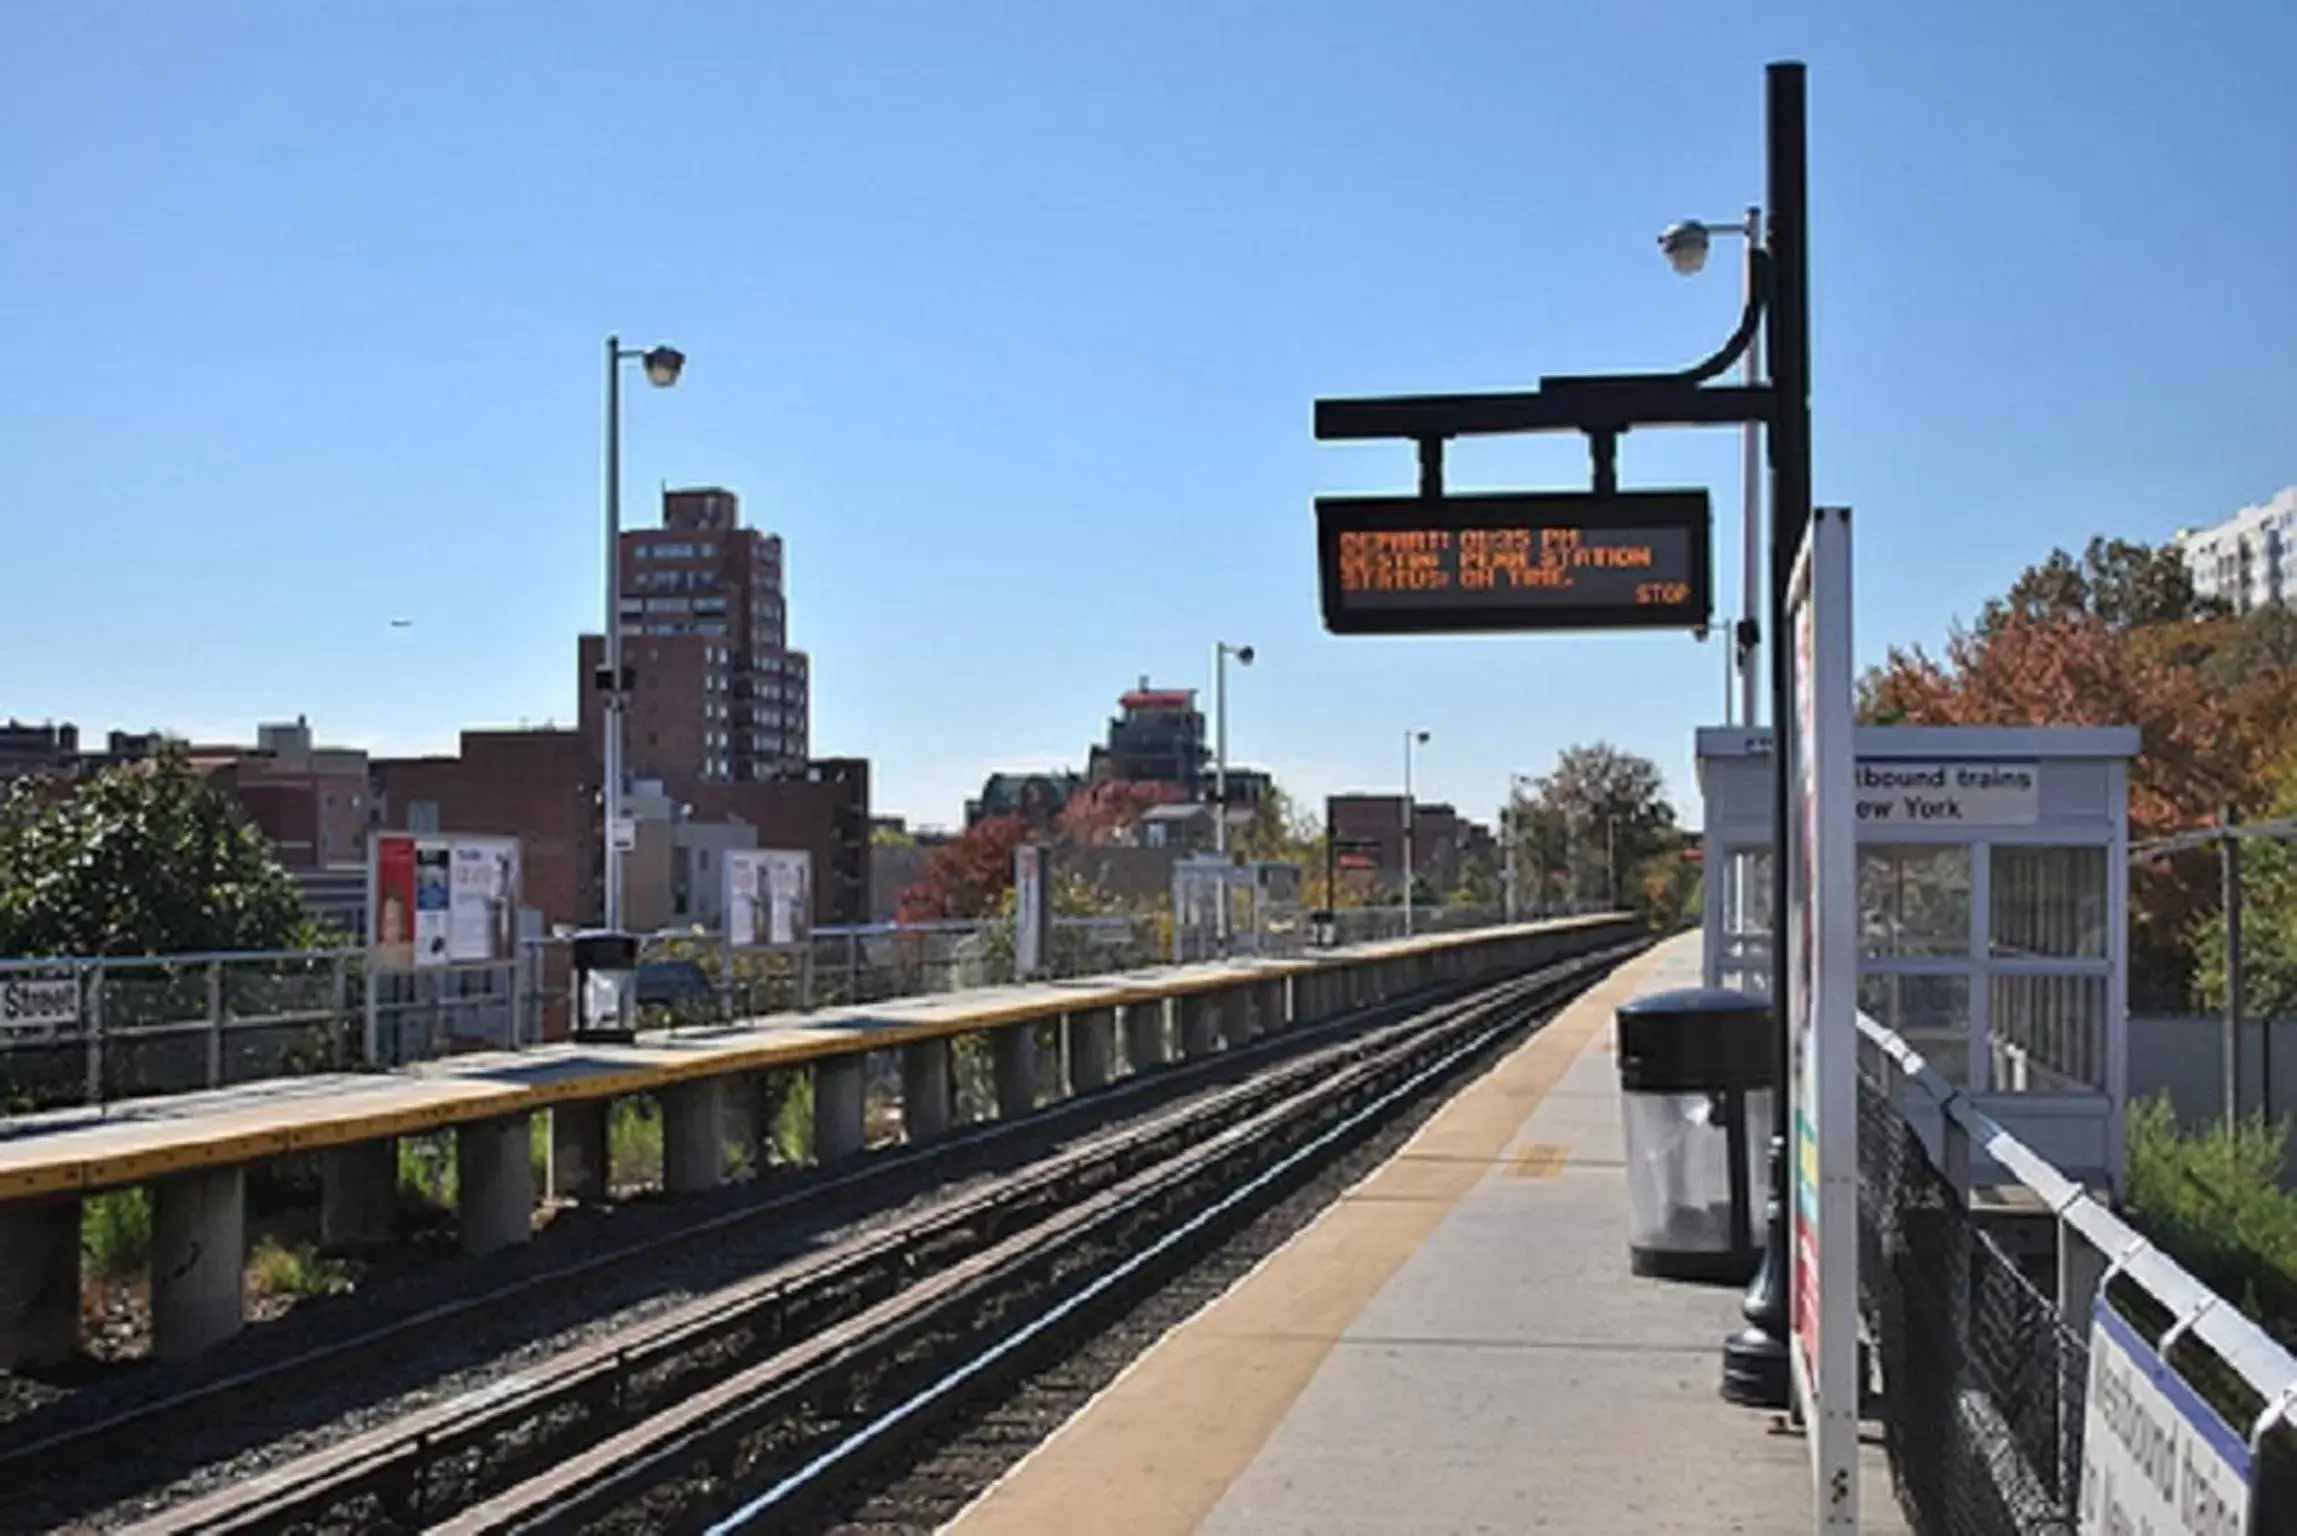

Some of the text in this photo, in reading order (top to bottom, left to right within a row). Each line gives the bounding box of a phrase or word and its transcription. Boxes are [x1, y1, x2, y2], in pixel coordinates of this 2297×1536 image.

[1635, 582, 1691, 604] STOP
[1956, 764, 2032, 791] trains
[1904, 796, 1963, 820] York
